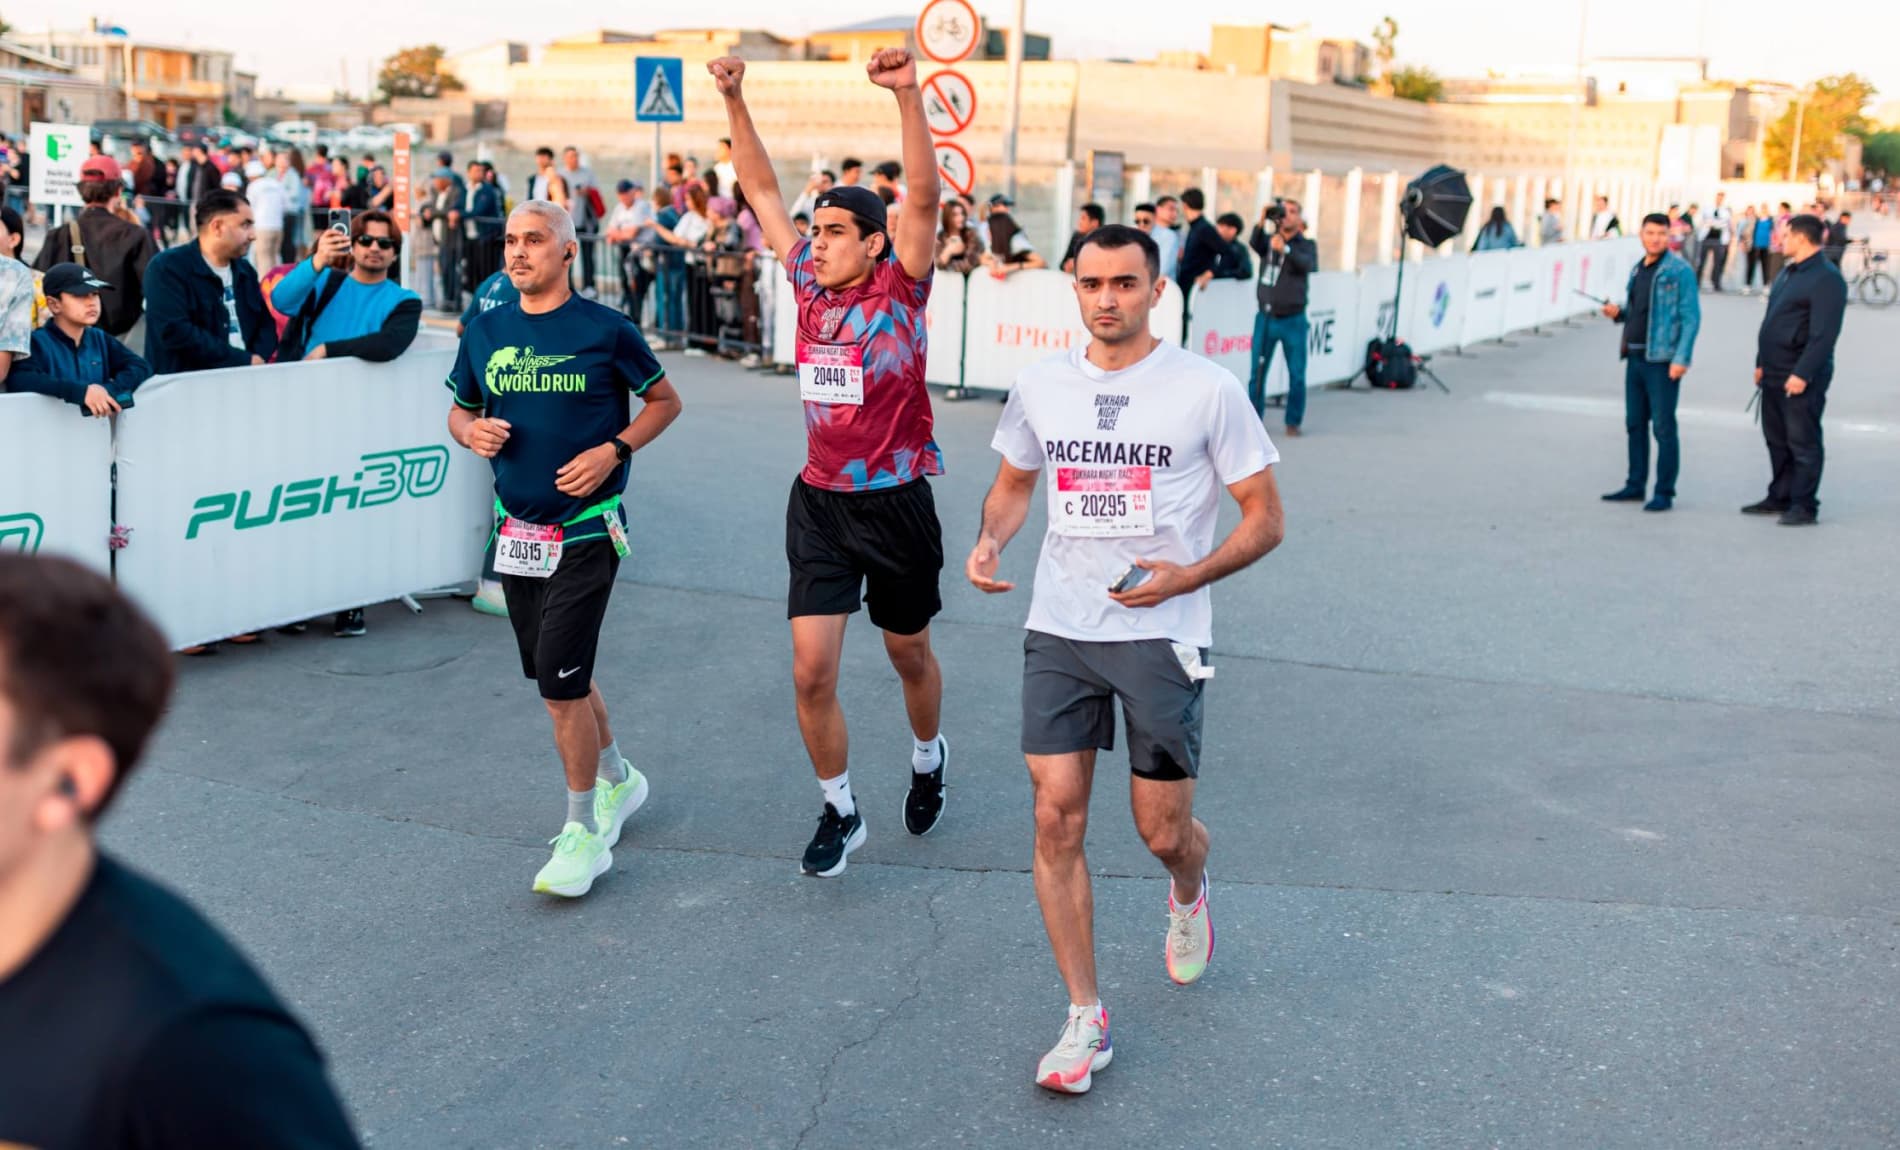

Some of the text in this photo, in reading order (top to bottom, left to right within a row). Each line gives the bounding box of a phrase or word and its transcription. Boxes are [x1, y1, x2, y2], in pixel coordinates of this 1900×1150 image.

[814, 366, 846, 387] 20448
[1094, 394, 1130, 407] BUKHARA
[1097, 407, 1121, 418] NIGHT
[1097, 418, 1118, 431] RACE
[1046, 440, 1173, 467] PACEMAKER
[1099, 469, 1117, 480] NIGHT
[1081, 494, 1127, 517] 20295
[1134, 503, 1146, 511] km
[509, 540, 541, 561] 20315
